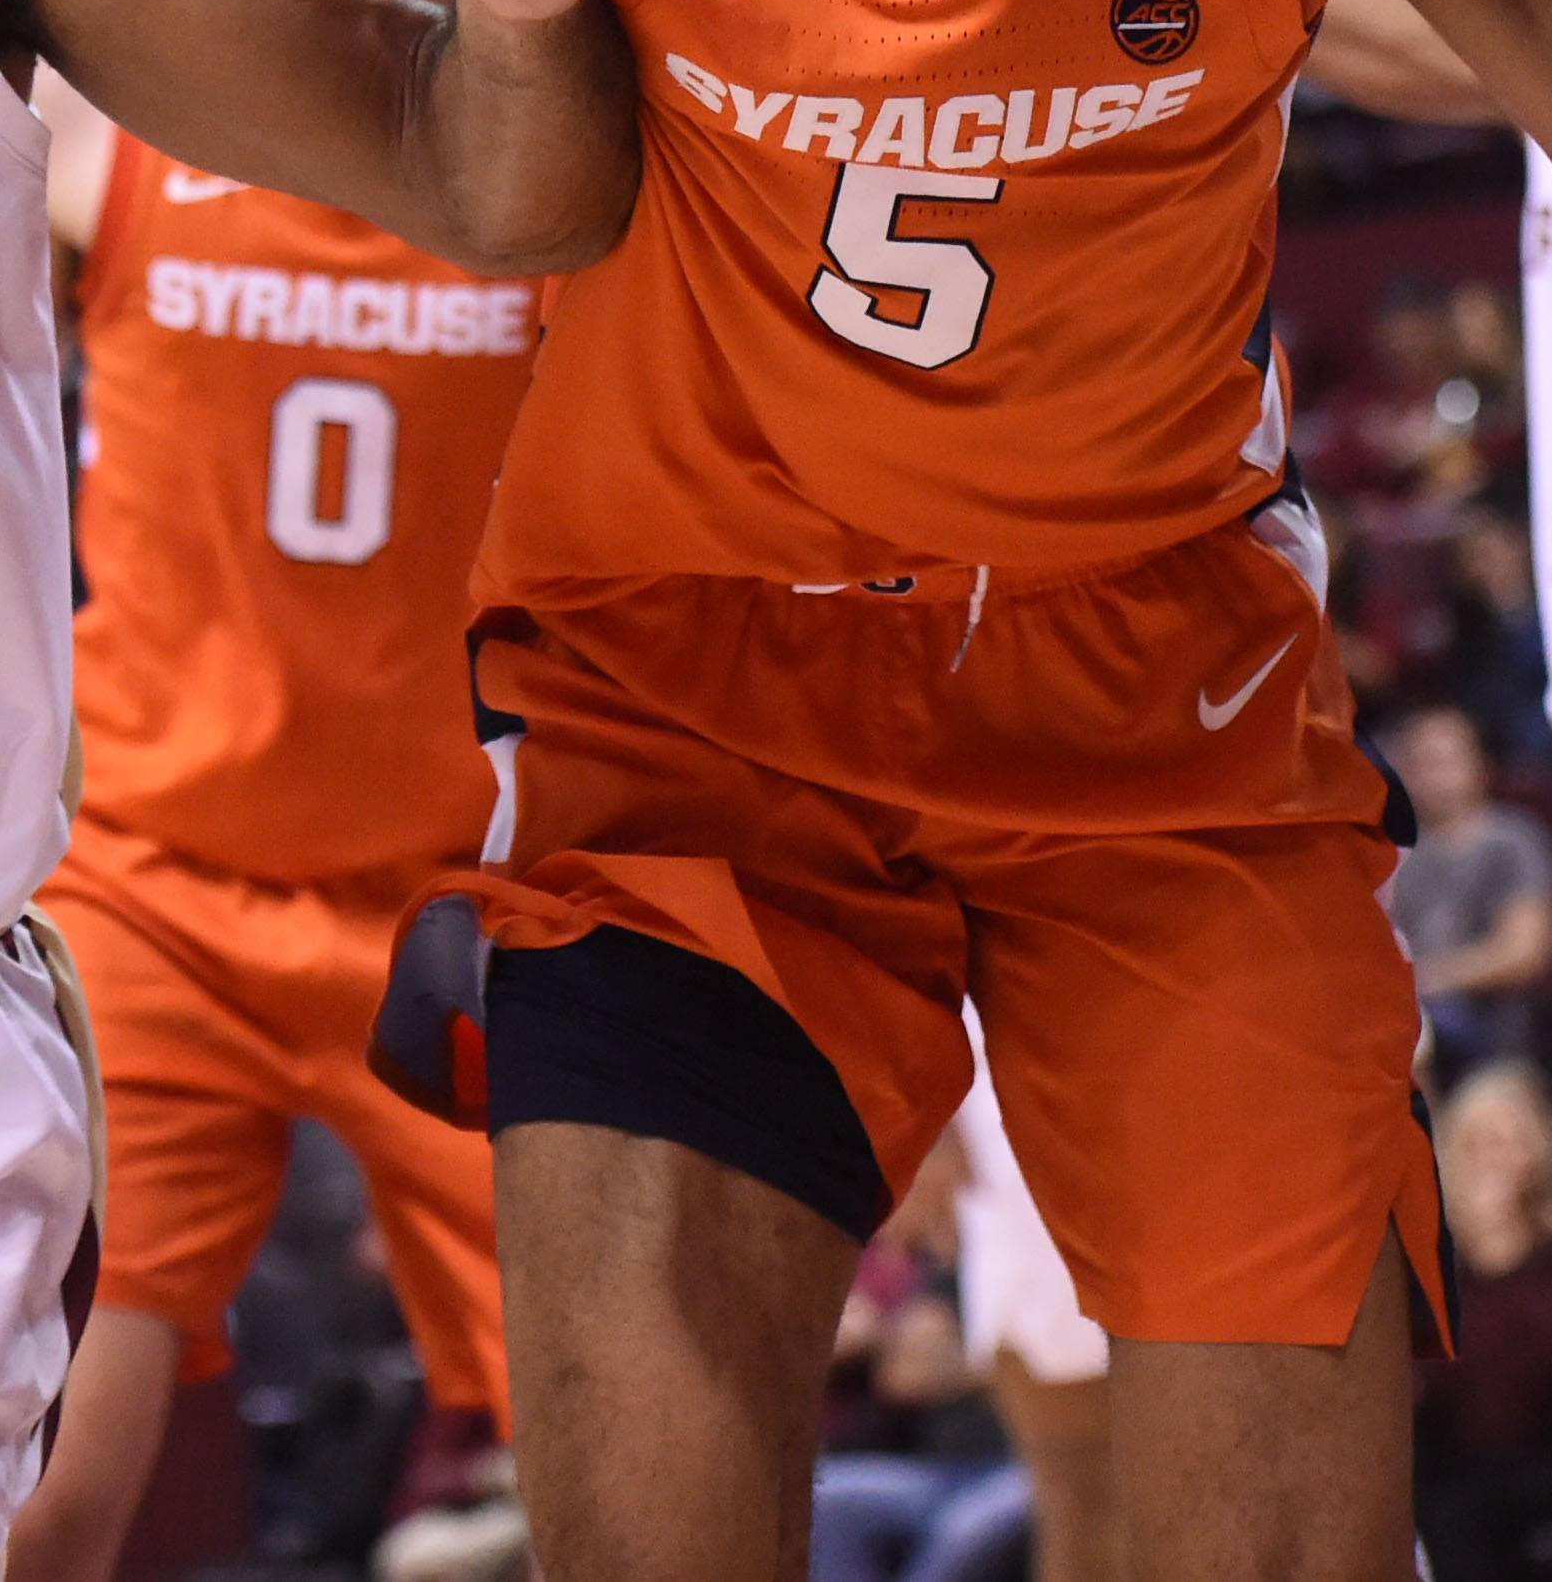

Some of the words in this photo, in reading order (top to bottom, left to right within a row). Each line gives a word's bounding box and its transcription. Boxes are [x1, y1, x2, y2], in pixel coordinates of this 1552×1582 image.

[1125, 1, 1191, 24] ACC
[665, 51, 1206, 169] SYRACUSE
[149, 255, 534, 357] SYRACUSE
[805, 162, 1006, 370] 5
[265, 374, 399, 566] 0
